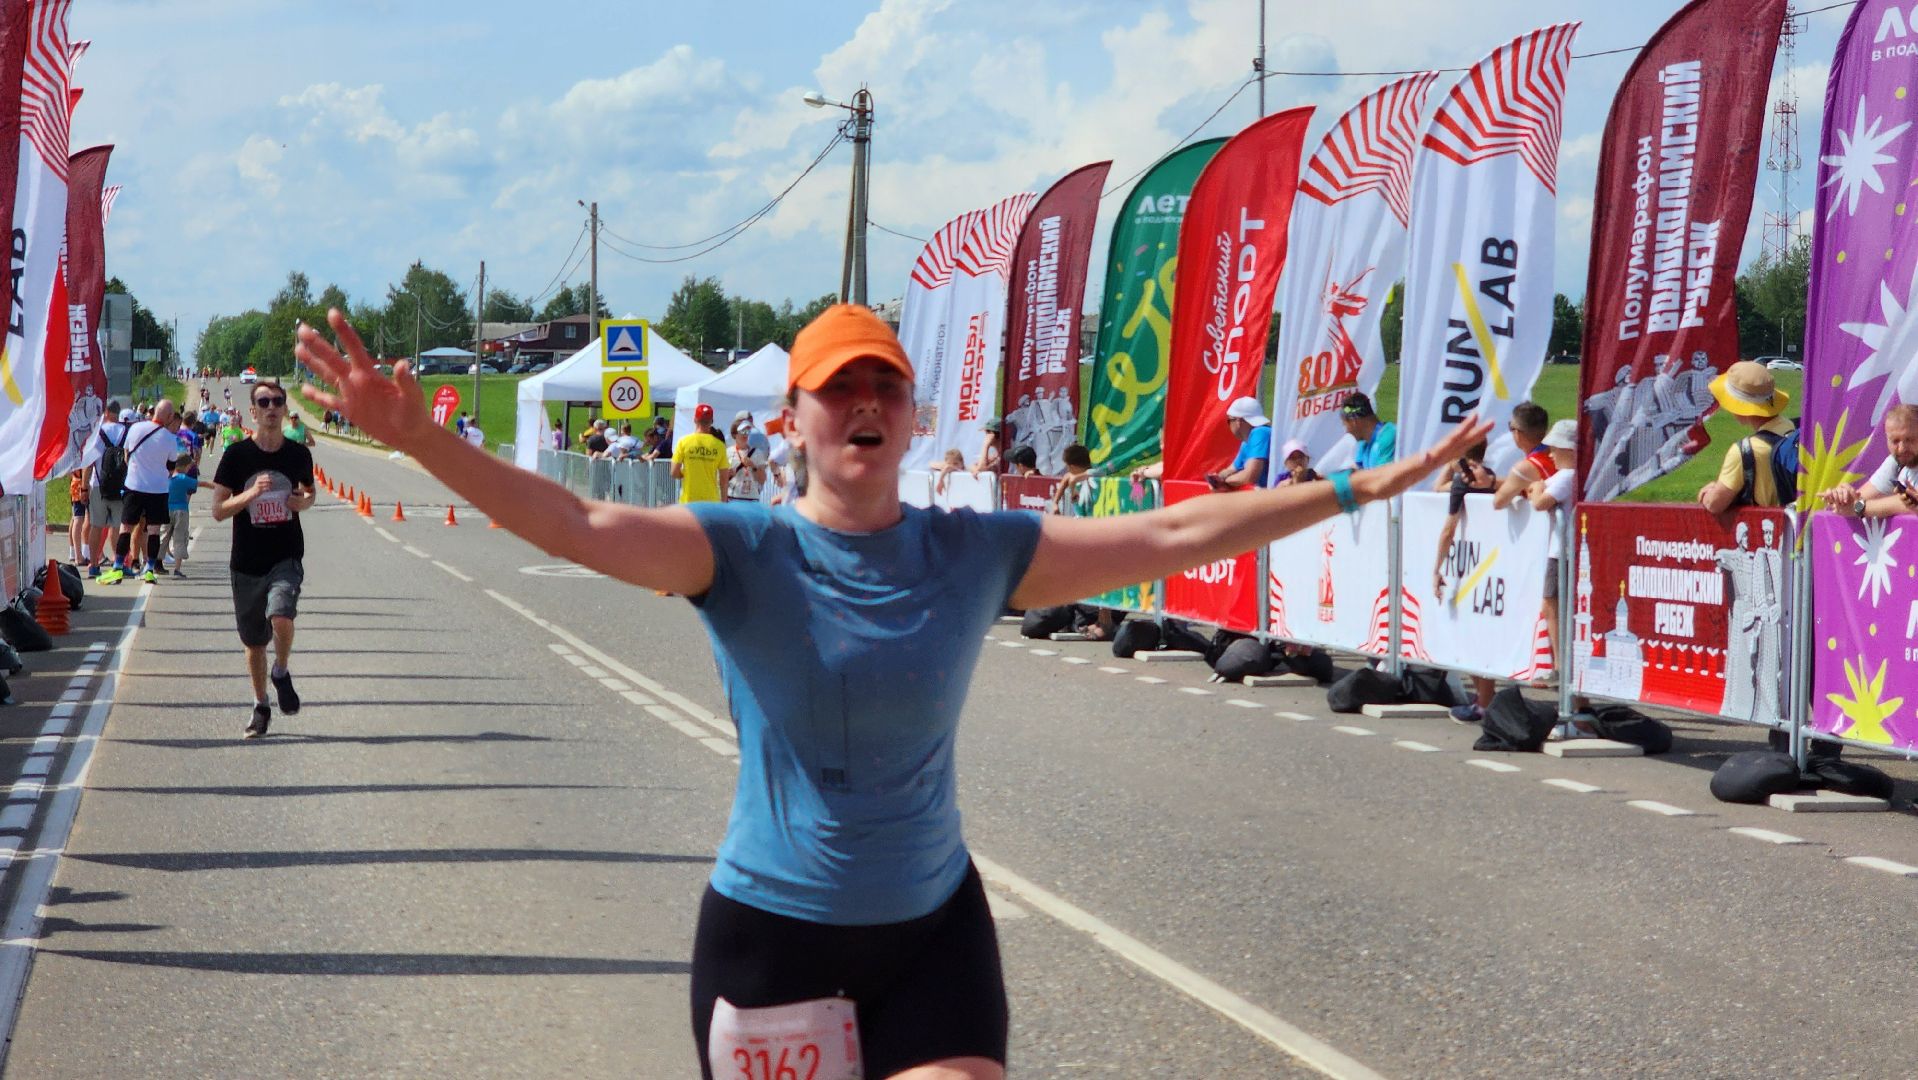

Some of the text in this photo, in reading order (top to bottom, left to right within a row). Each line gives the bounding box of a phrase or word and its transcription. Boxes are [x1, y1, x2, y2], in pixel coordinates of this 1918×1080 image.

[1647, 60, 1700, 334] ВОЛОКОЛАМСКИЙ
[1619, 136, 1654, 341] Полумарафон
[1036, 216, 1061, 376] ВОЛОКОЛАМСКИЙ
[1203, 231, 1232, 374] Советский
[1479, 237, 1518, 338] LAB
[1679, 219, 1720, 329] РУБЕЖ
[68, 303, 91, 373] РУБЕЖ
[1019, 259, 1037, 381] Полумарафон
[1048, 308, 1072, 373] РУБЕЖ
[616, 386, 637, 402] 20
[1298, 351, 1333, 395] 80
[1441, 319, 1483, 424] RUN
[433, 403, 447, 427] 11
[256, 501, 282, 516] 3014
[1446, 540, 1480, 578] RUN
[1636, 535, 1714, 564] Полумарафон
[1473, 576, 1504, 617] LAB
[1655, 602, 1694, 637] РУБЕЖ
